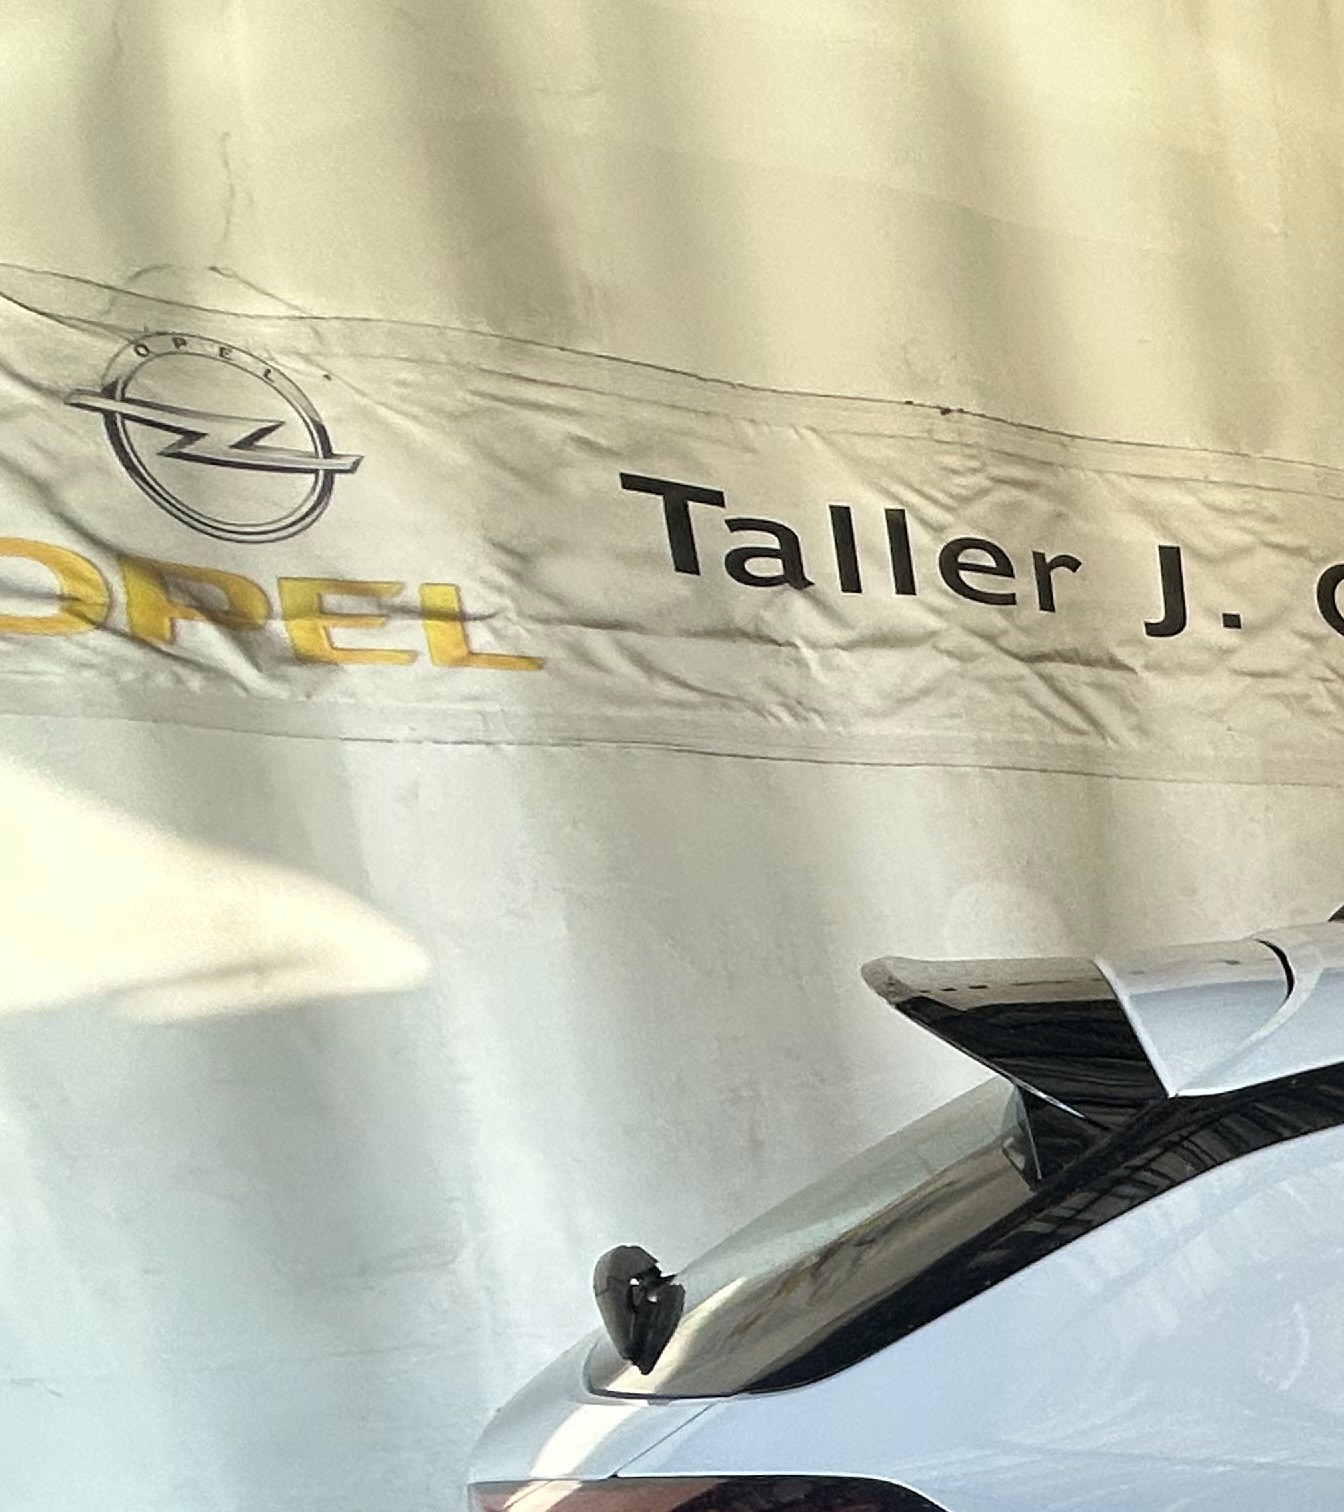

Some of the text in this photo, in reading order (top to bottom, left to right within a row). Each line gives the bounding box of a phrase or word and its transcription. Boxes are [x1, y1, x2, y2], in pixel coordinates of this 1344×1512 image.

[131, 335, 277, 384] OPEL
[619, 472, 1082, 613] Taller
[1144, 544, 1242, 638] J.
